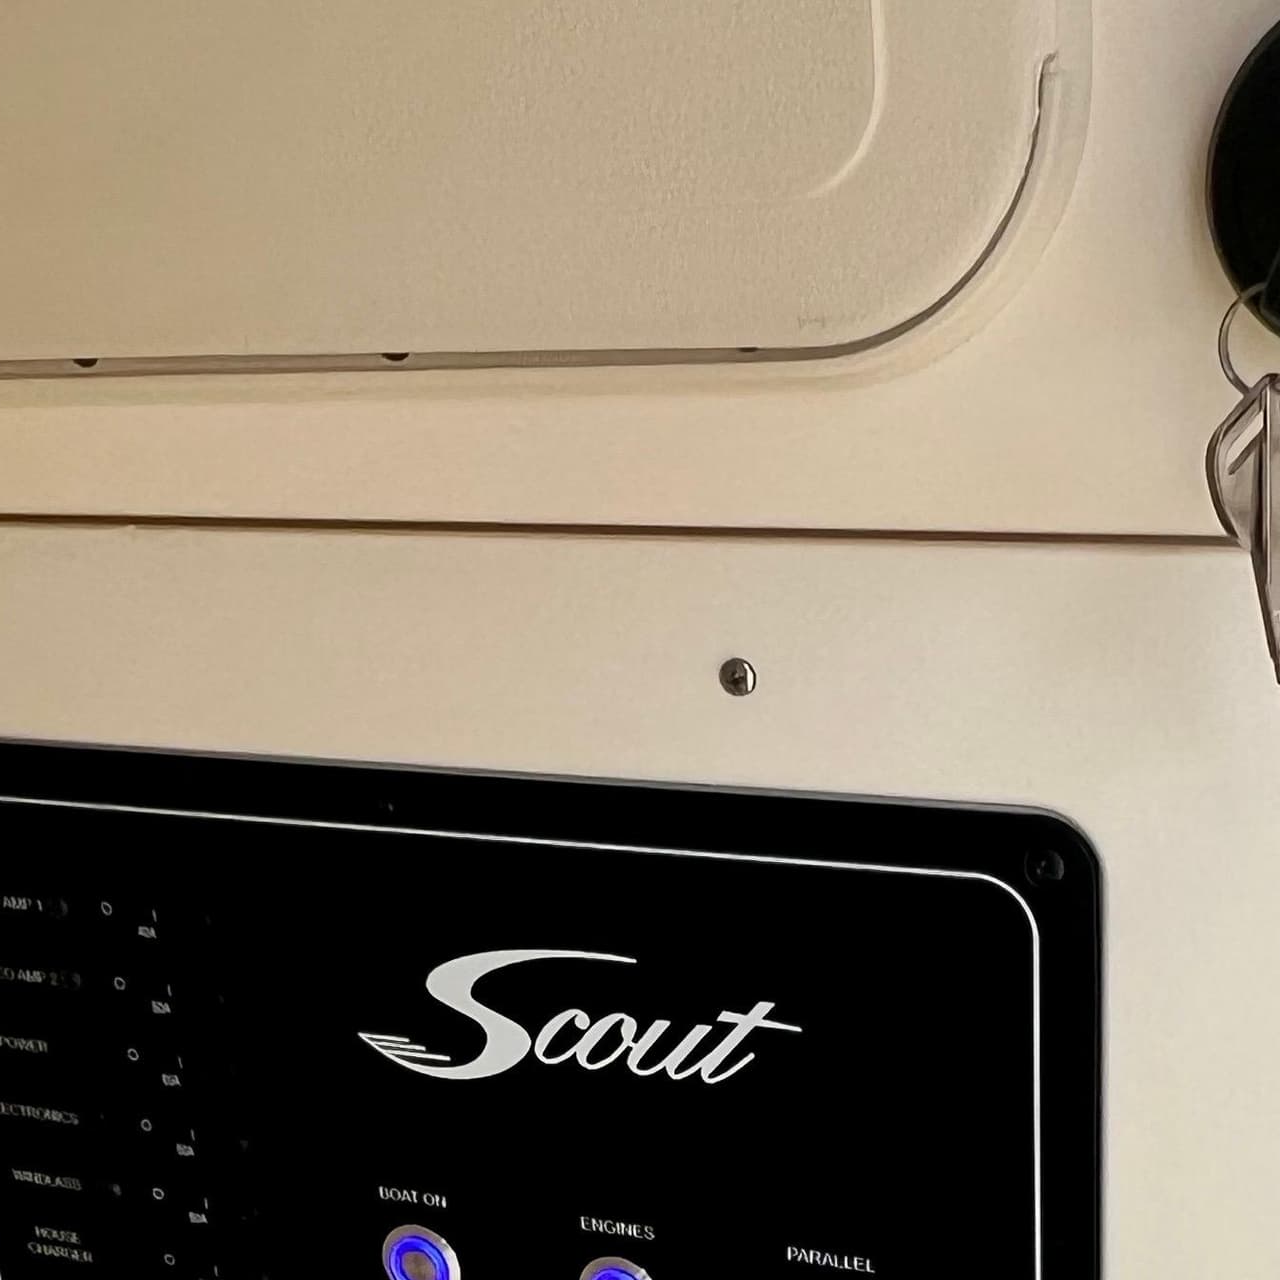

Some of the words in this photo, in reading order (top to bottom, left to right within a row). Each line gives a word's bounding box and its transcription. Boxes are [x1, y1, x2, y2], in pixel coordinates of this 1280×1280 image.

[358, 948, 802, 1084] Scout
[378, 1186, 418, 1205] BOAT
[423, 1192, 447, 1209] ON
[579, 1215, 656, 1241] ENGINES
[786, 1246, 876, 1274] PARALLEL
